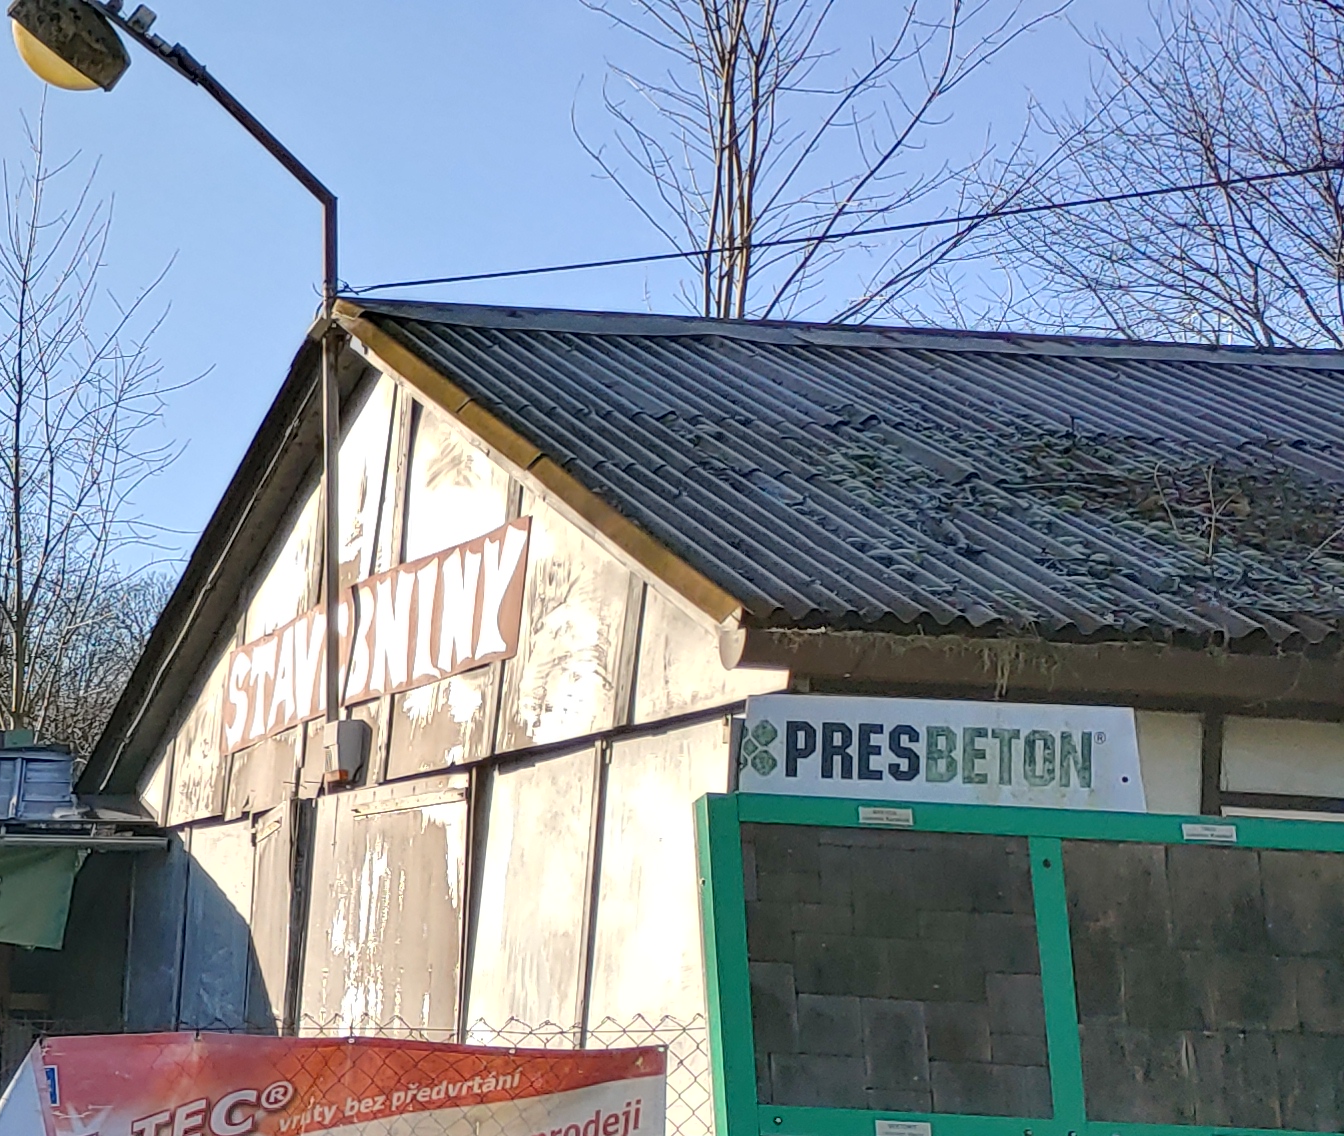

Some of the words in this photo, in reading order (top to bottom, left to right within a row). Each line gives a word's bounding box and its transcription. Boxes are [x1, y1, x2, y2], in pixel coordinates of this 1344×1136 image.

[278, 1102, 337, 1132] vruty
[344, 1092, 385, 1118] bez
[391, 1068, 524, 1111] předvrtání
